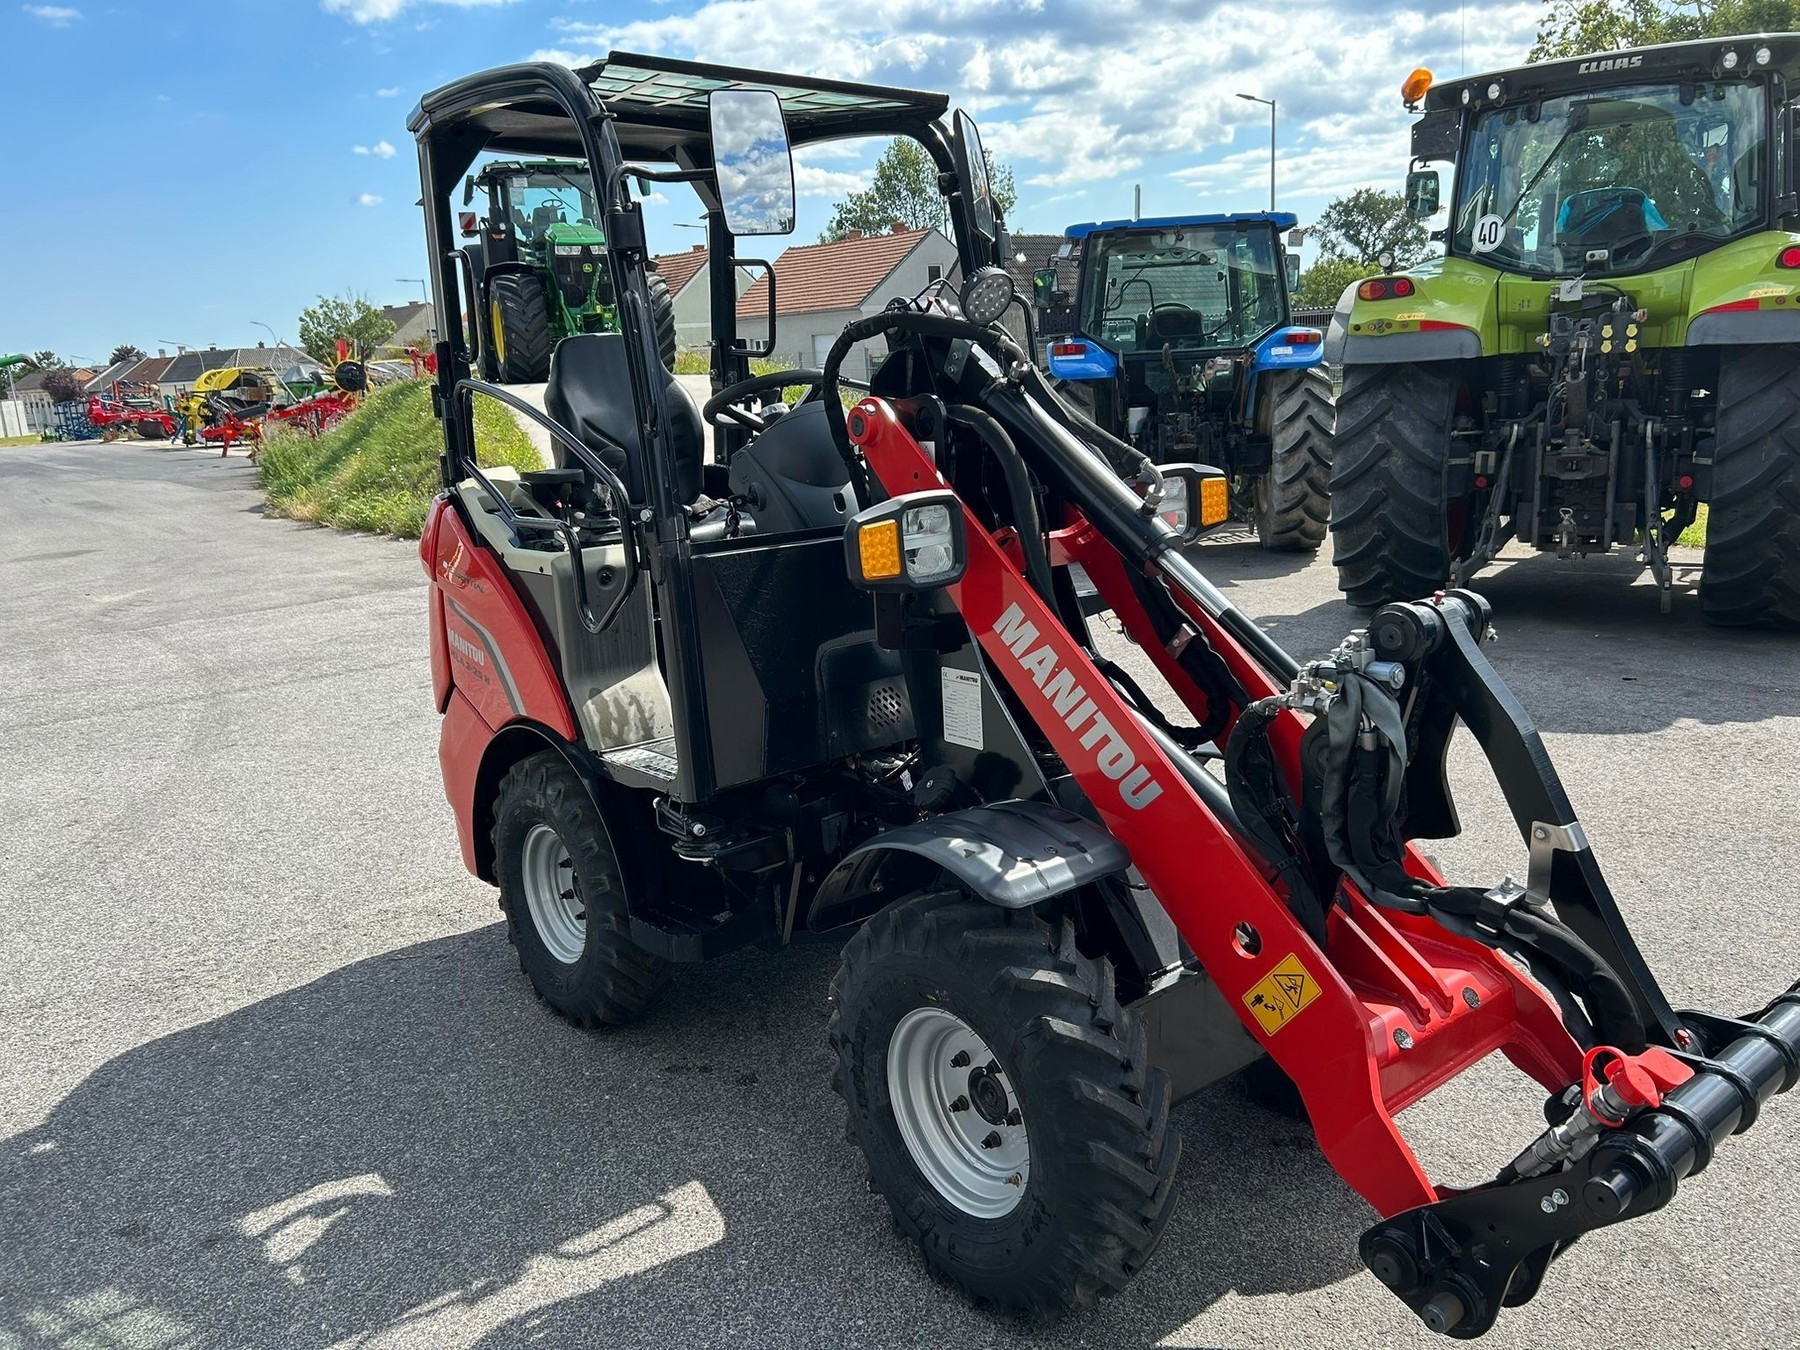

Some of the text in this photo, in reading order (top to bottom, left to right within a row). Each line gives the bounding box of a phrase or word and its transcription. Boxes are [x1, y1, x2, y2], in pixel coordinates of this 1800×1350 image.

[1578, 55, 1643, 74] CLAAS
[1478, 221, 1498, 245] 40
[448, 628, 484, 666] MANITOU
[992, 601, 1164, 811] MANITOU
